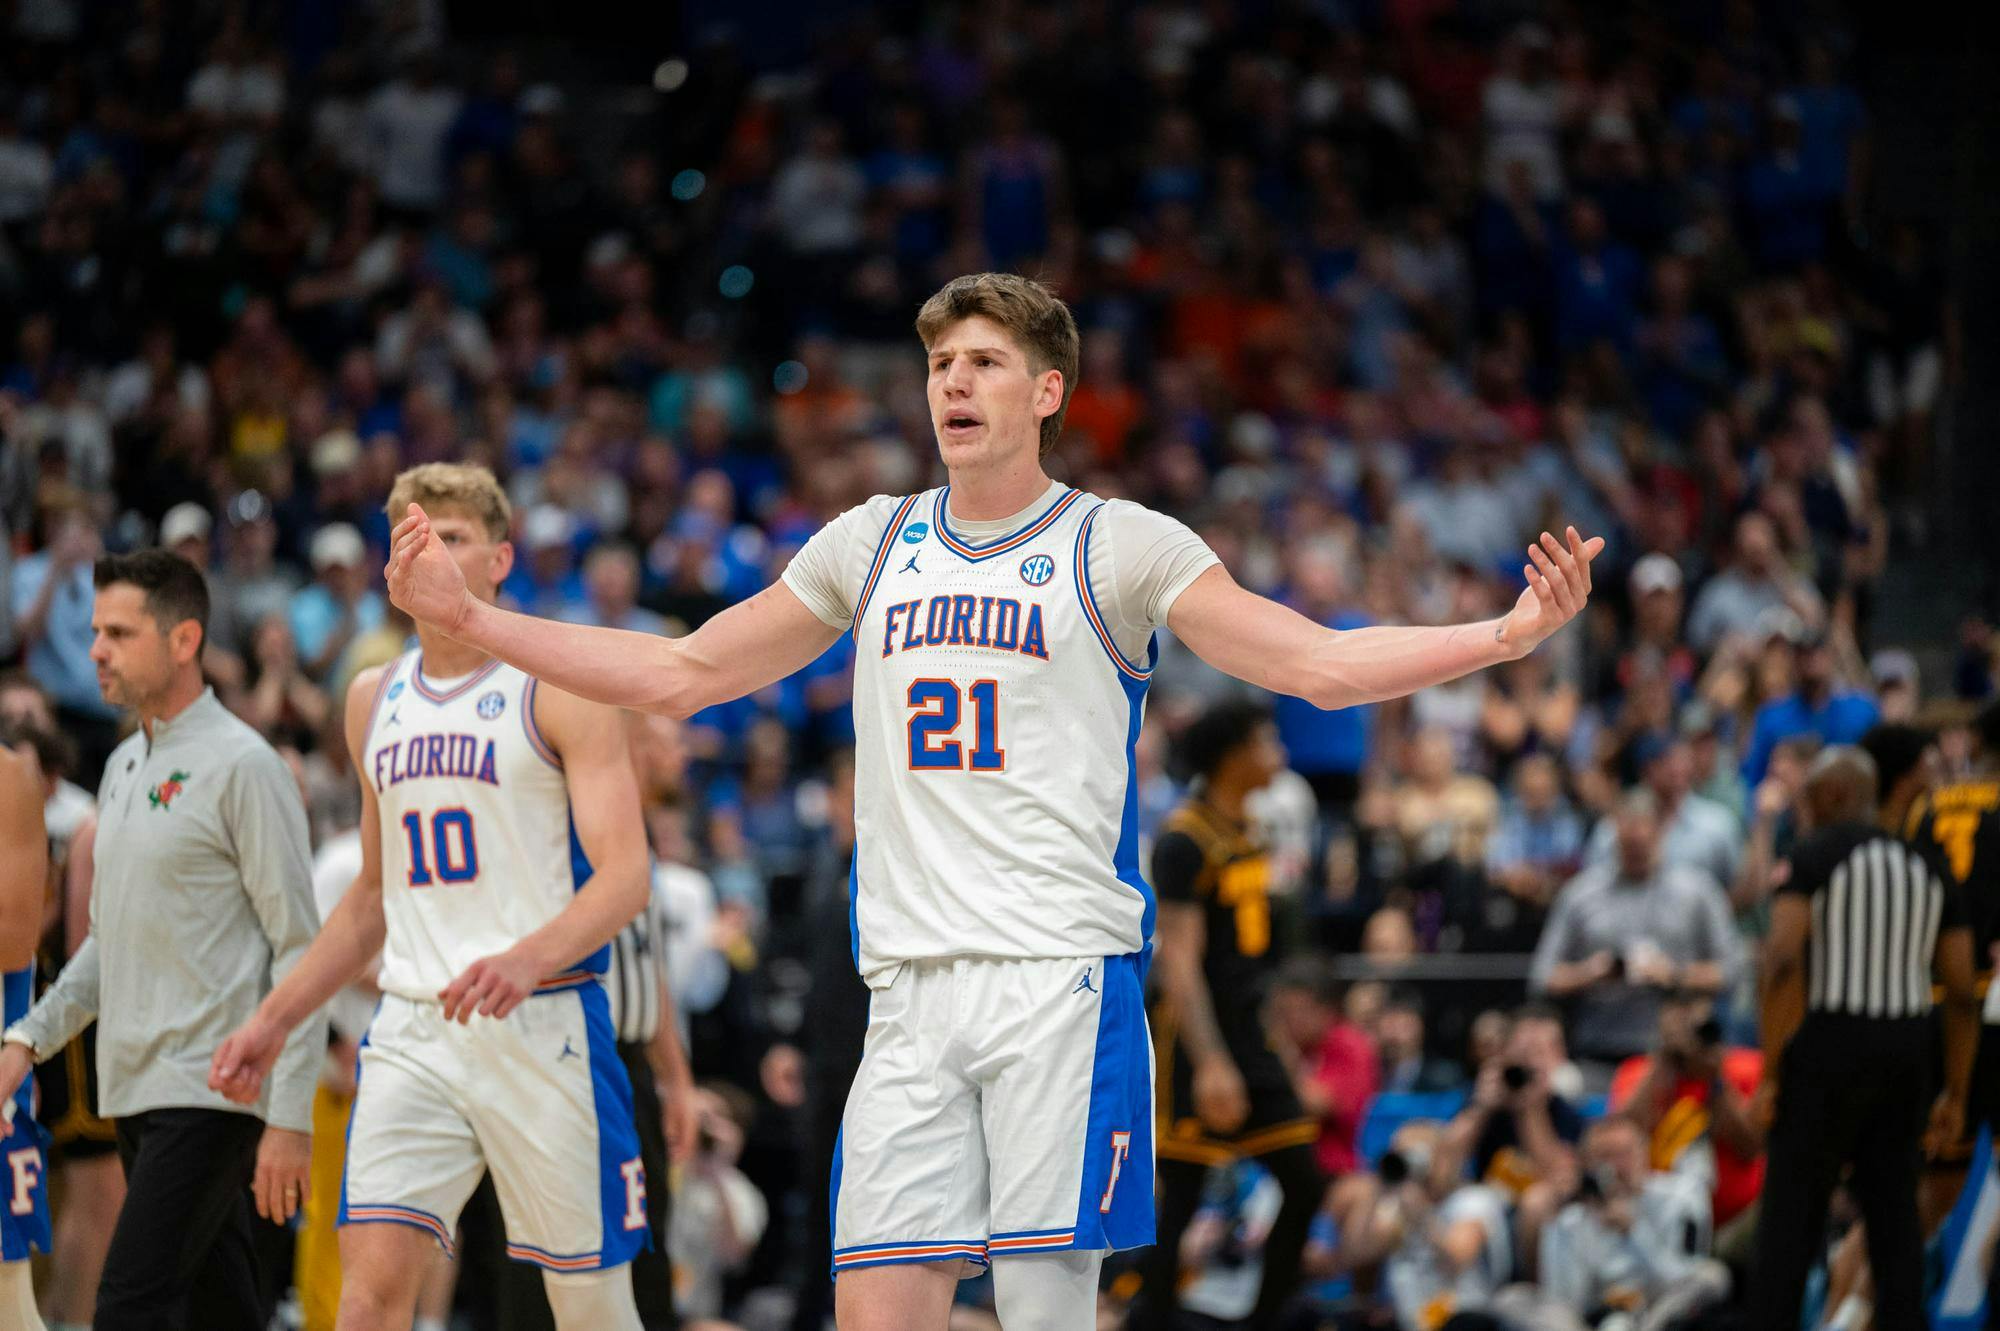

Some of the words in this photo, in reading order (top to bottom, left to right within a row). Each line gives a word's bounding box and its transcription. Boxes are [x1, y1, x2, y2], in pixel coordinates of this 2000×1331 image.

[1021, 556, 1053, 584] SEC
[881, 593, 1050, 662] FLORIDA
[906, 677, 1006, 772] 21
[375, 732, 500, 795] FLORIDA
[401, 805, 481, 888] 10
[7, 1146, 42, 1216] F
[620, 1155, 647, 1232] F
